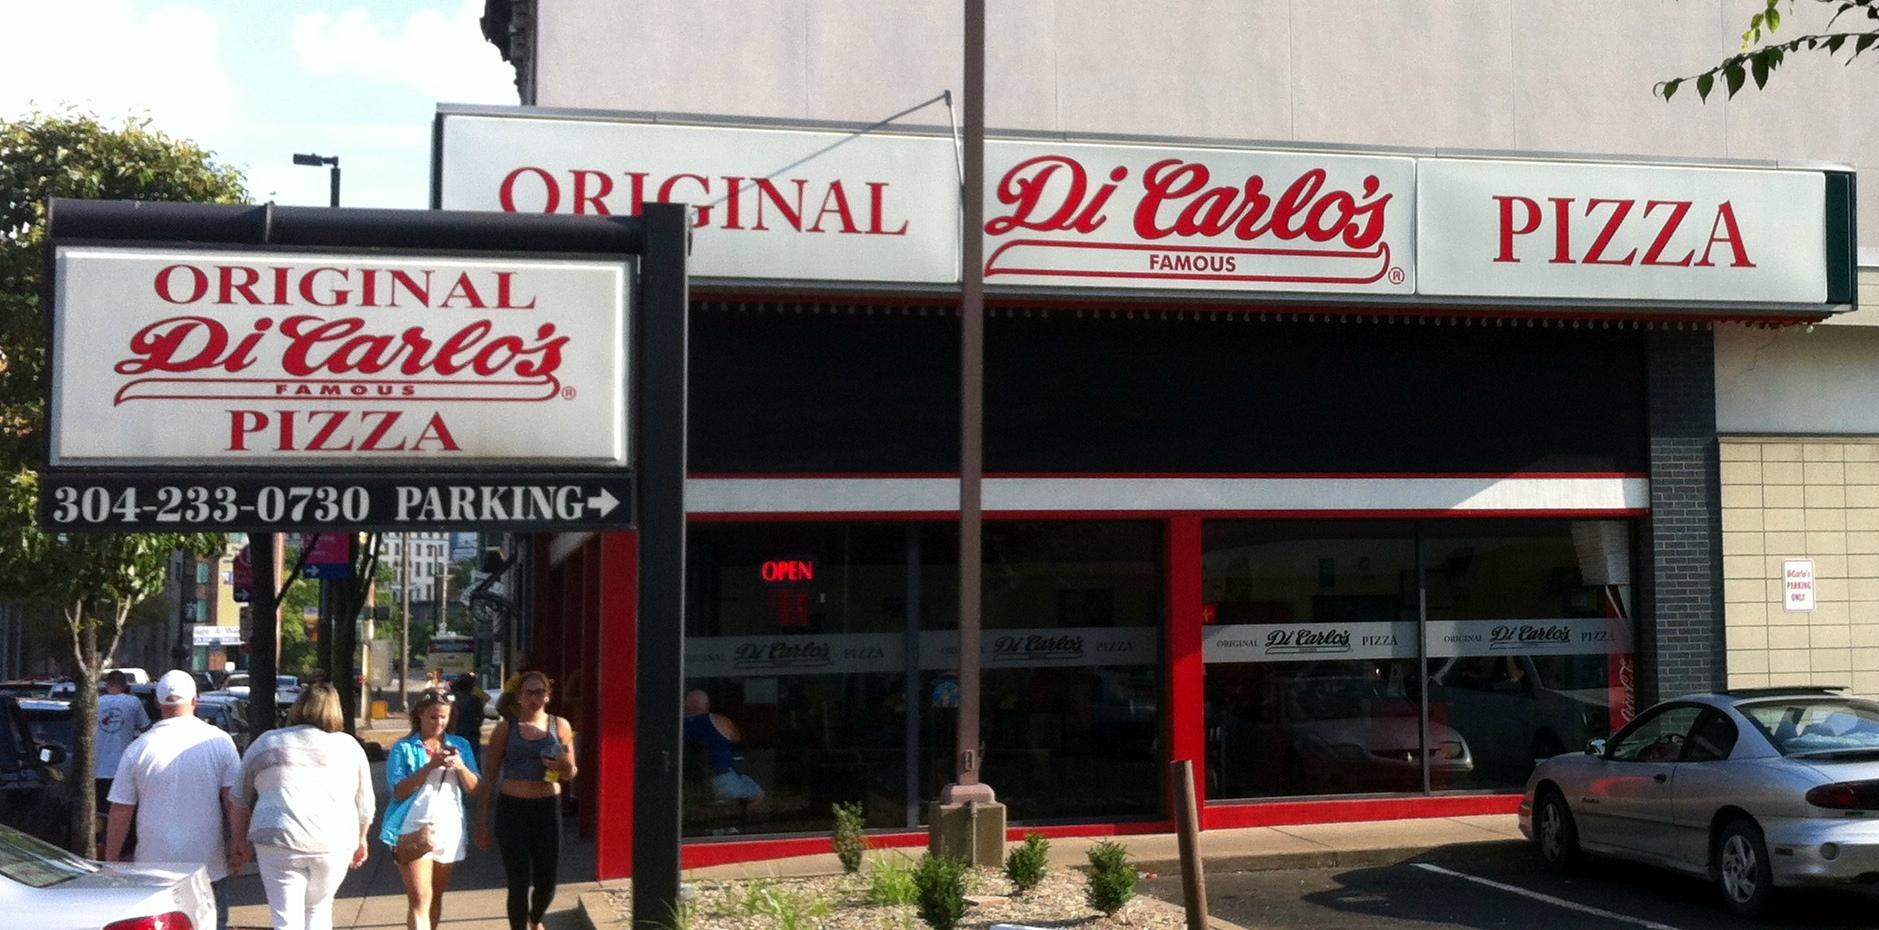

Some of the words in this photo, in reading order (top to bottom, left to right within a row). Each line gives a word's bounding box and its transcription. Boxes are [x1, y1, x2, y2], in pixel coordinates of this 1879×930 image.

[499, 166, 909, 236] ORIGINAL
[984, 154, 1128, 237] Di
[1133, 158, 1393, 250] Carlo's
[1493, 194, 1756, 268] PIZZA
[1149, 254, 1237, 273] FAMOUS
[153, 263, 537, 311] ORIGINAL
[113, 315, 274, 376] Di
[279, 314, 571, 378] Carlo's
[274, 382, 417, 397] FAMOUS
[226, 409, 463, 453] PIZZA
[52, 485, 371, 524] 304-233-0730
[395, 484, 587, 521] PARKING
[761, 560, 815, 582] OPEN
[1787, 581, 1812, 590] PARKING
[1791, 593, 1806, 602] ONLY
[1216, 639, 1259, 648] ORIGINAL
[1361, 634, 1399, 647] PIZZA
[1443, 634, 1483, 643] ORIGINAL
[1581, 631, 1616, 643] PIZZA
